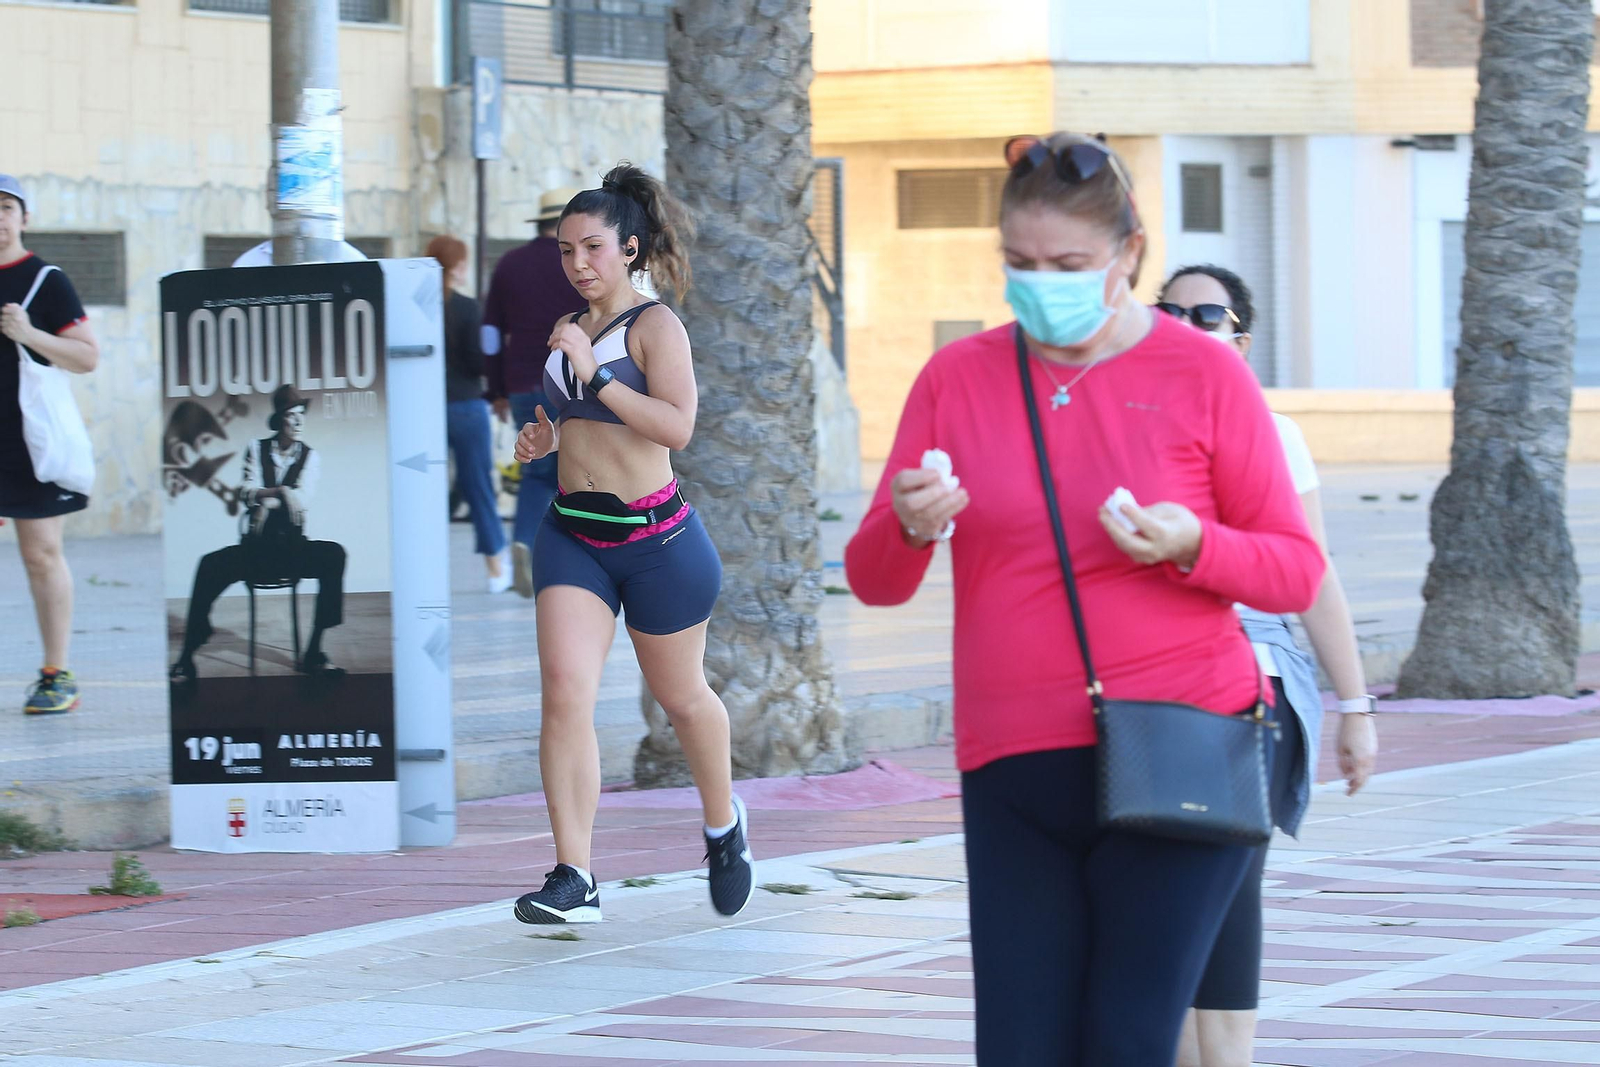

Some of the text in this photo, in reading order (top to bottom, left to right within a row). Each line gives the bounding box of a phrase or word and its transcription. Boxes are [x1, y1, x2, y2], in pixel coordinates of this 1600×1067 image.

[164, 299, 376, 397] LOQUILLO
[184, 736, 262, 766] 19 jun
[277, 730, 382, 749] ALMERÍA
